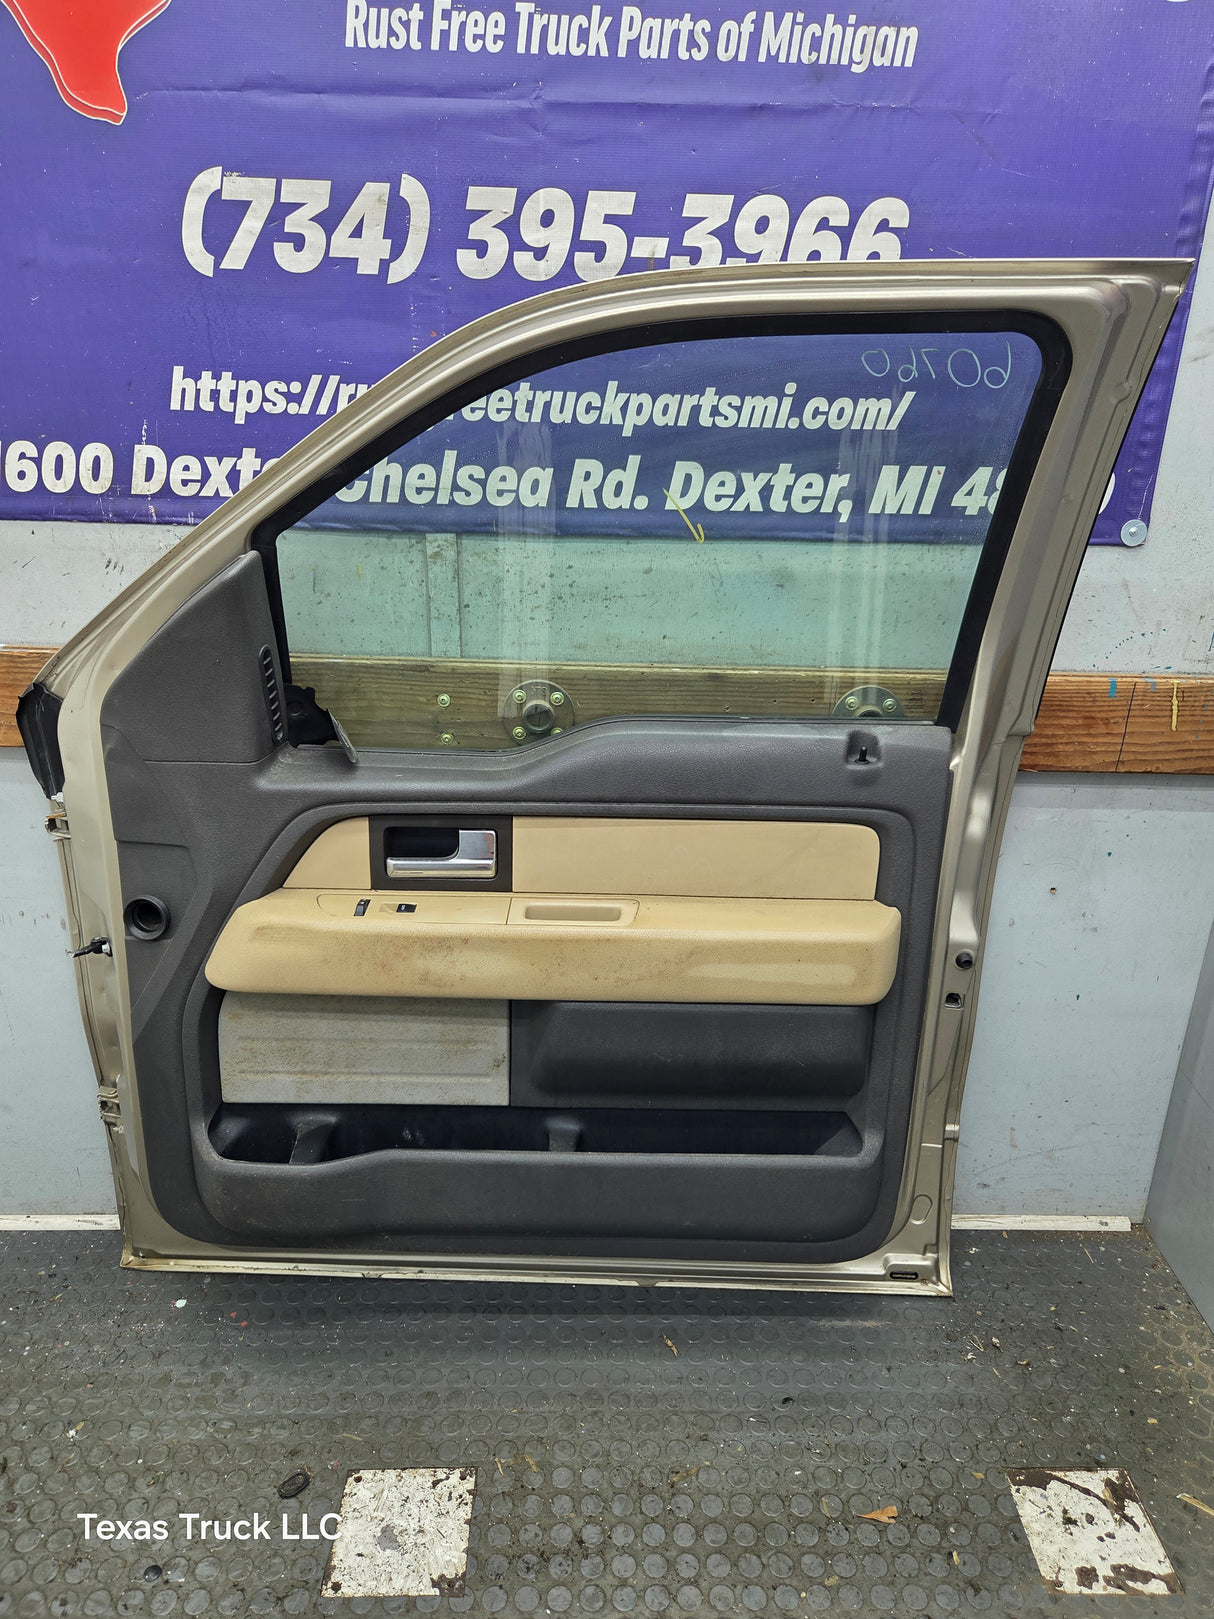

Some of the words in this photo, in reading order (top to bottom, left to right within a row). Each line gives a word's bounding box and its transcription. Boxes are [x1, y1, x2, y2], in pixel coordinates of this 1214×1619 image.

[345, 0, 424, 50] Rust
[430, 0, 506, 53] Free
[515, 2, 613, 57] Truck
[617, 6, 711, 60] Parts
[717, 11, 757, 61] of
[758, 11, 919, 73] Michigan
[181, 166, 431, 284] (734)
[456, 186, 910, 282] 395-3966
[0, 440, 114, 495] 600
[131, 442, 281, 498] Dext
[565, 455, 649, 510] Rd.
[664, 461, 854, 523] Dexter,
[868, 465, 946, 515] MI
